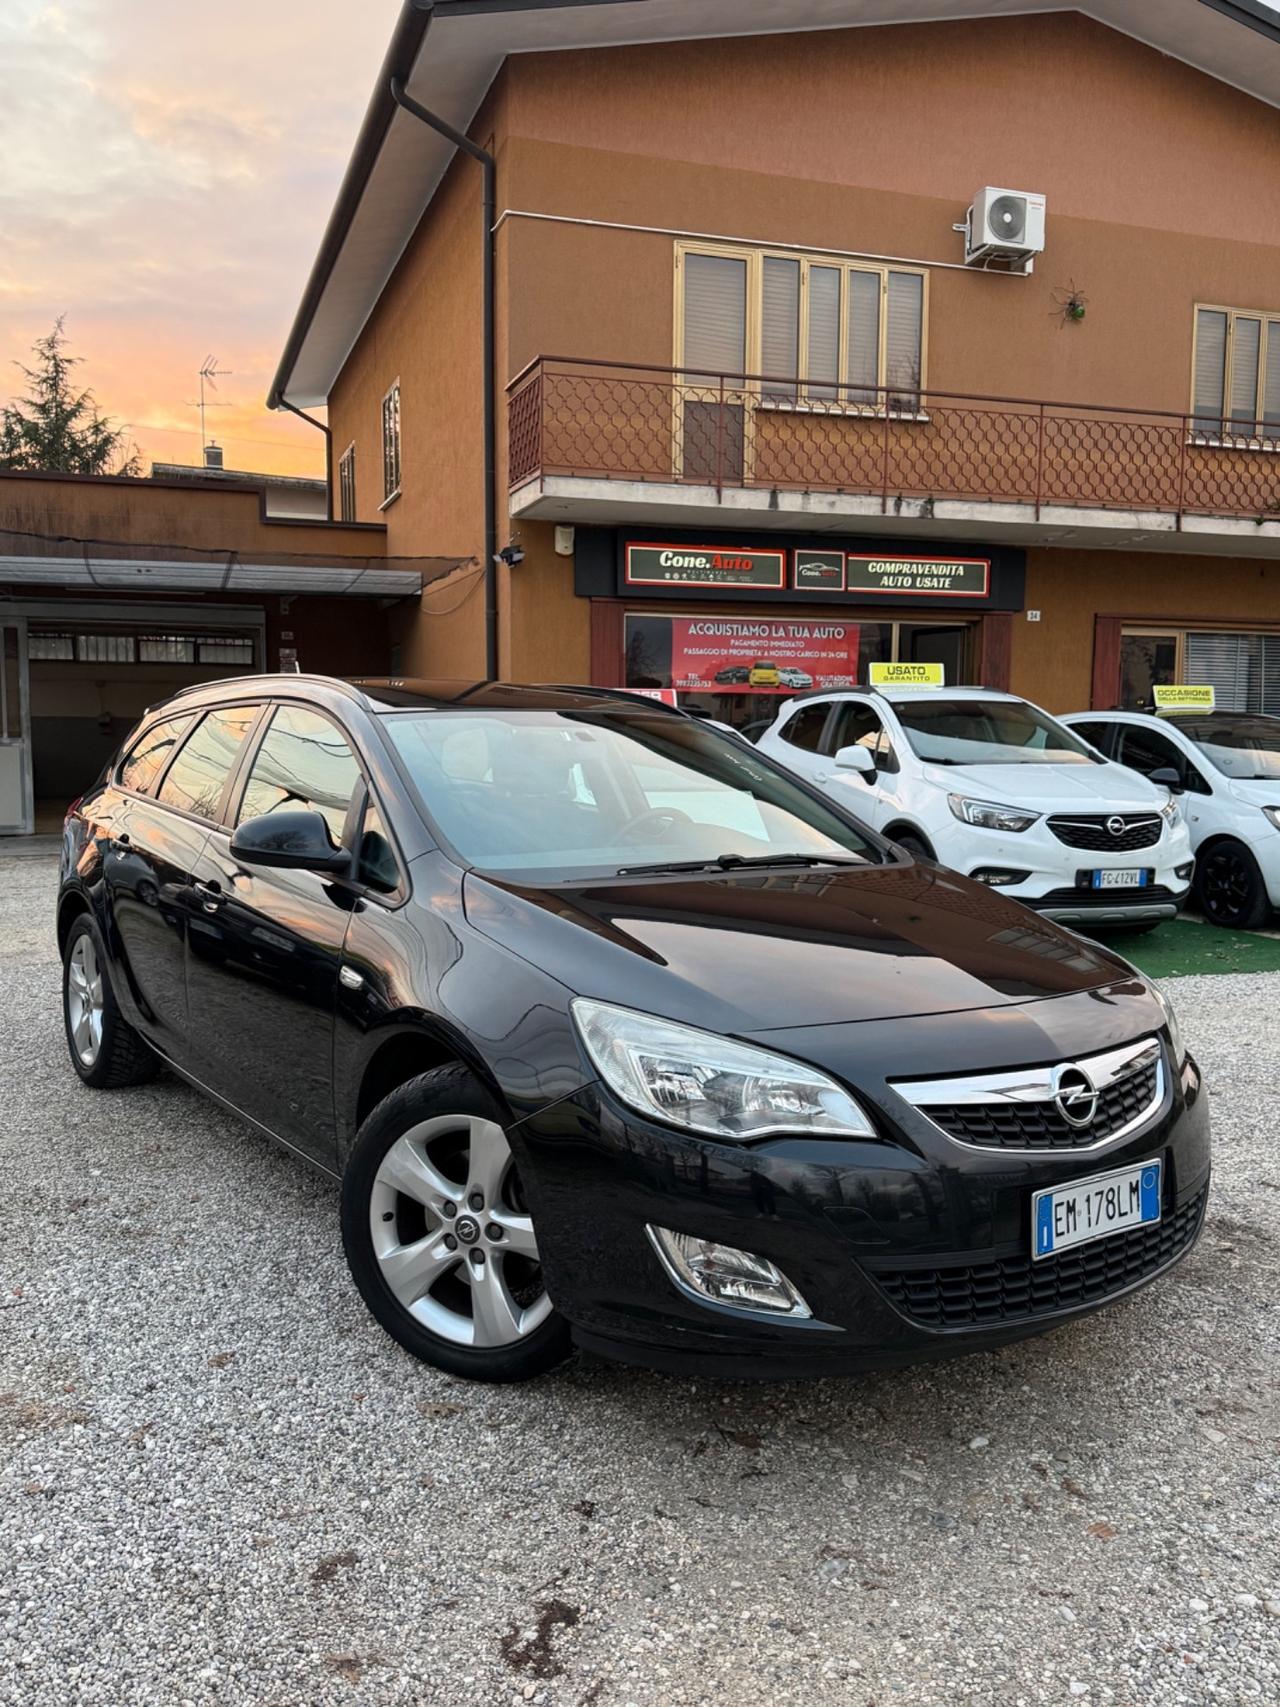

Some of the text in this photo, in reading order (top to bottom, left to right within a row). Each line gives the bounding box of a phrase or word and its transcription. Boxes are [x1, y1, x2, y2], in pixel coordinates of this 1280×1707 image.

[868, 562, 964, 576] COMPRAVENDITA
[880, 576, 952, 588] AUTO USATE
[688, 622, 845, 639] ACQUISTIAMO LA TUA AUTO
[730, 639, 805, 648] PAGAMENTO IMMEDIATO
[683, 647, 720, 656] PASSAGGIO
[770, 650, 795, 658] NOSTRO
[797, 651, 820, 659] CARICO
[887, 666, 926, 675] USATO
[1055, 1179, 1140, 1237] EM 178LM
